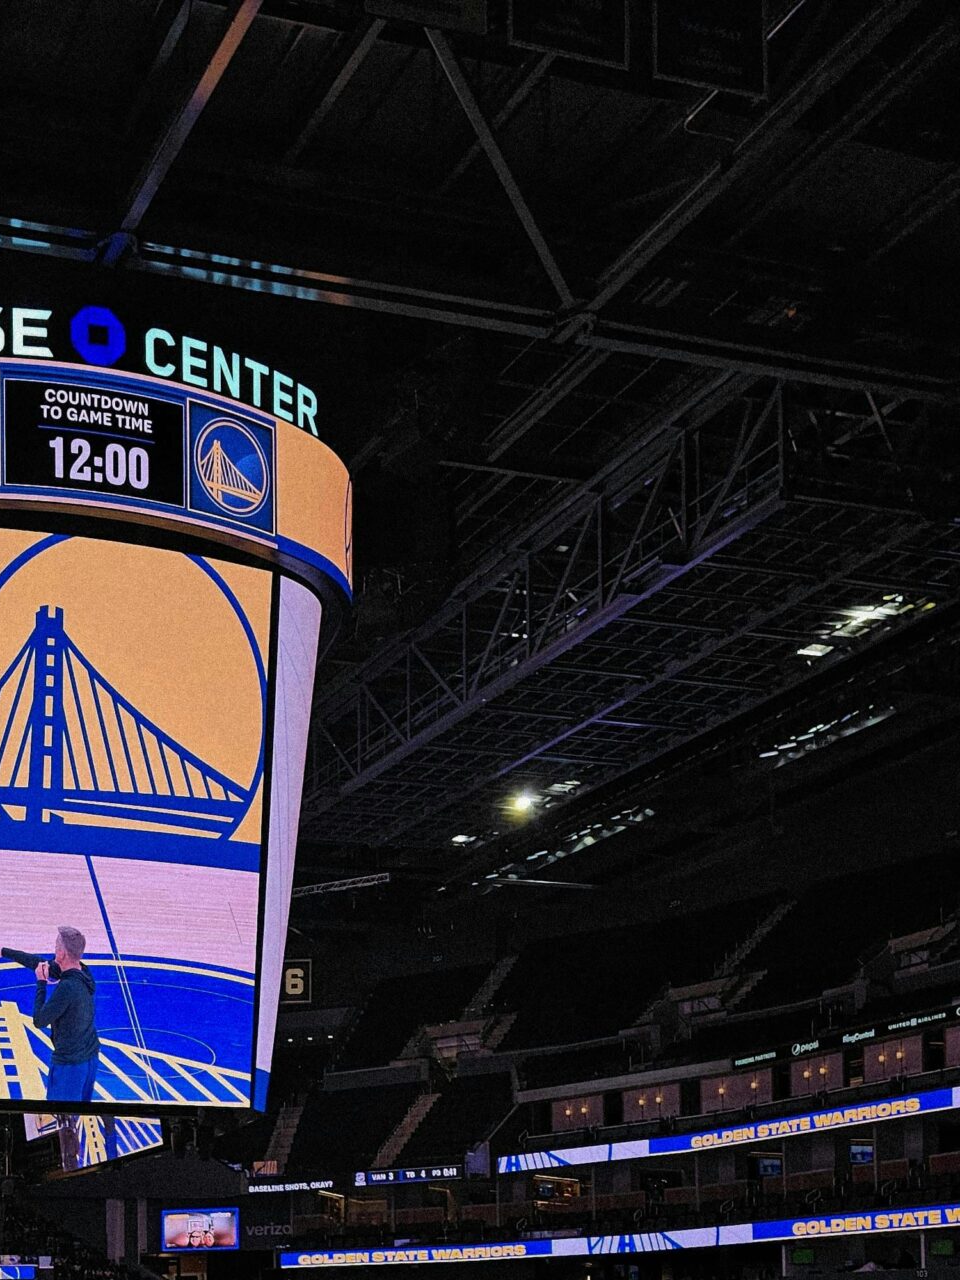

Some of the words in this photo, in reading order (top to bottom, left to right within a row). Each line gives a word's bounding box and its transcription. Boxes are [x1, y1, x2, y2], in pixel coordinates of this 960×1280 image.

[144, 327, 319, 436] CENTER
[44, 388, 149, 416] COUNTDOWN
[40, 404, 62, 419] TO
[66, 407, 113, 426] GAME
[115, 414, 153, 433] TIME
[48, 436, 149, 490] 12:00
[285, 967, 305, 995] 6
[887, 1020, 911, 1031] UNITED
[917, 1012, 947, 1025] AIRLINES
[800, 1040, 819, 1054] pepsi
[690, 1126, 756, 1149] GOLDEN
[757, 1116, 811, 1136] STATE
[813, 1098, 921, 1128] WARRIORS
[248, 1182, 284, 1193] BASELINE
[284, 1182, 310, 1192] SHOTS,
[309, 1180, 334, 1191] OKAY?
[371, 1172, 387, 1181] VAN
[388, 1172, 394, 1181] 3
[420, 1170, 426, 1178] 4
[792, 1215, 872, 1236] GOLDEN
[874, 1209, 942, 1229] STATE
[297, 1252, 370, 1265] GOLDEN
[371, 1249, 429, 1262] STATE
[431, 1244, 527, 1260] WARRIORS
[916, 1269, 928, 1278] 103
